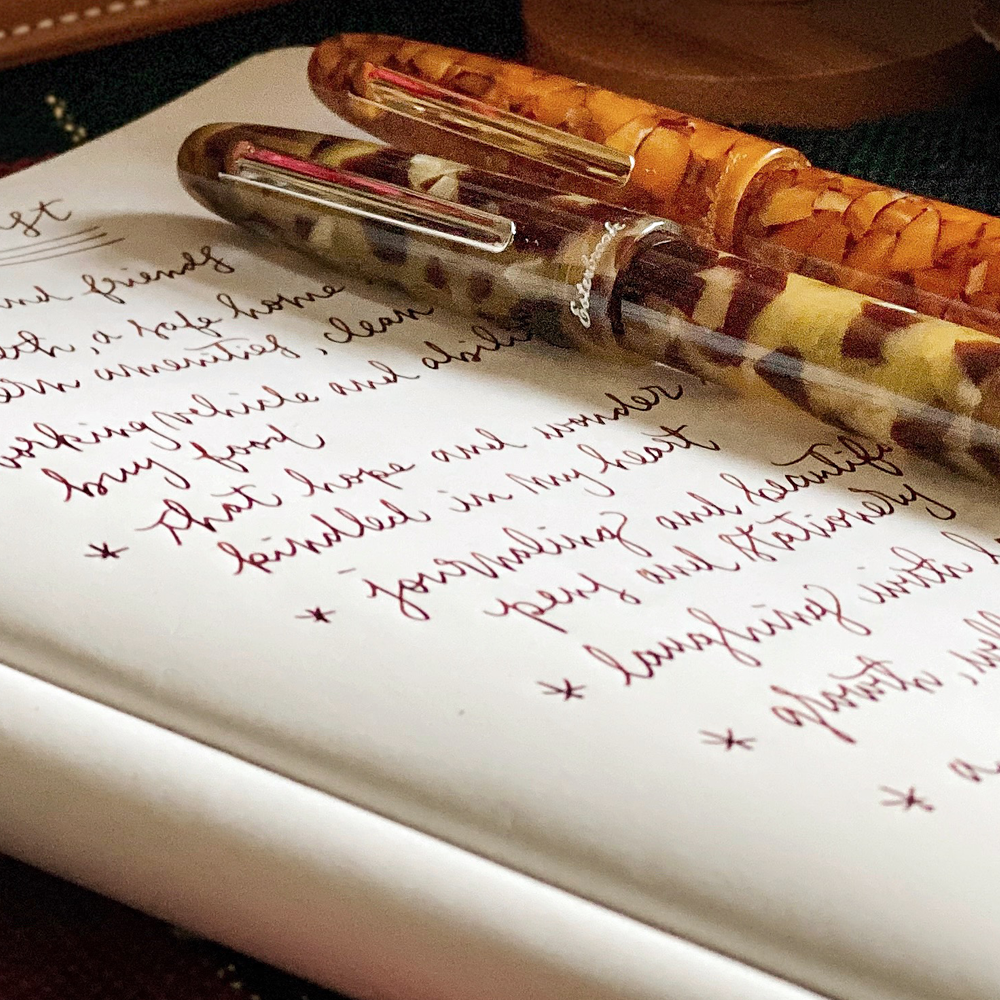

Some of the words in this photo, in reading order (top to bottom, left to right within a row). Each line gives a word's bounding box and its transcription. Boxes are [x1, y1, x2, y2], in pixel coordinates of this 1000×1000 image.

[0, 285, 73, 309] nd
[81, 245, 235, 305] friends
[217, 284, 345, 320] home
[329, 360, 420, 396] and
[190, 424, 325, 473] food
[283, 460, 415, 497] hope
[431, 428, 527, 462] and
[533, 384, 683, 440] wonder
[216, 499, 431, 575] kindled
[437, 490, 513, 513] in
[506, 468, 615, 497] my
[577, 424, 721, 474] heart
[340, 512, 653, 620] journaling
[656, 492, 742, 531] and
[483, 573, 641, 634] pens
[636, 546, 740, 584] and
[583, 584, 871, 686] laughing
[858, 546, 973, 604] with
